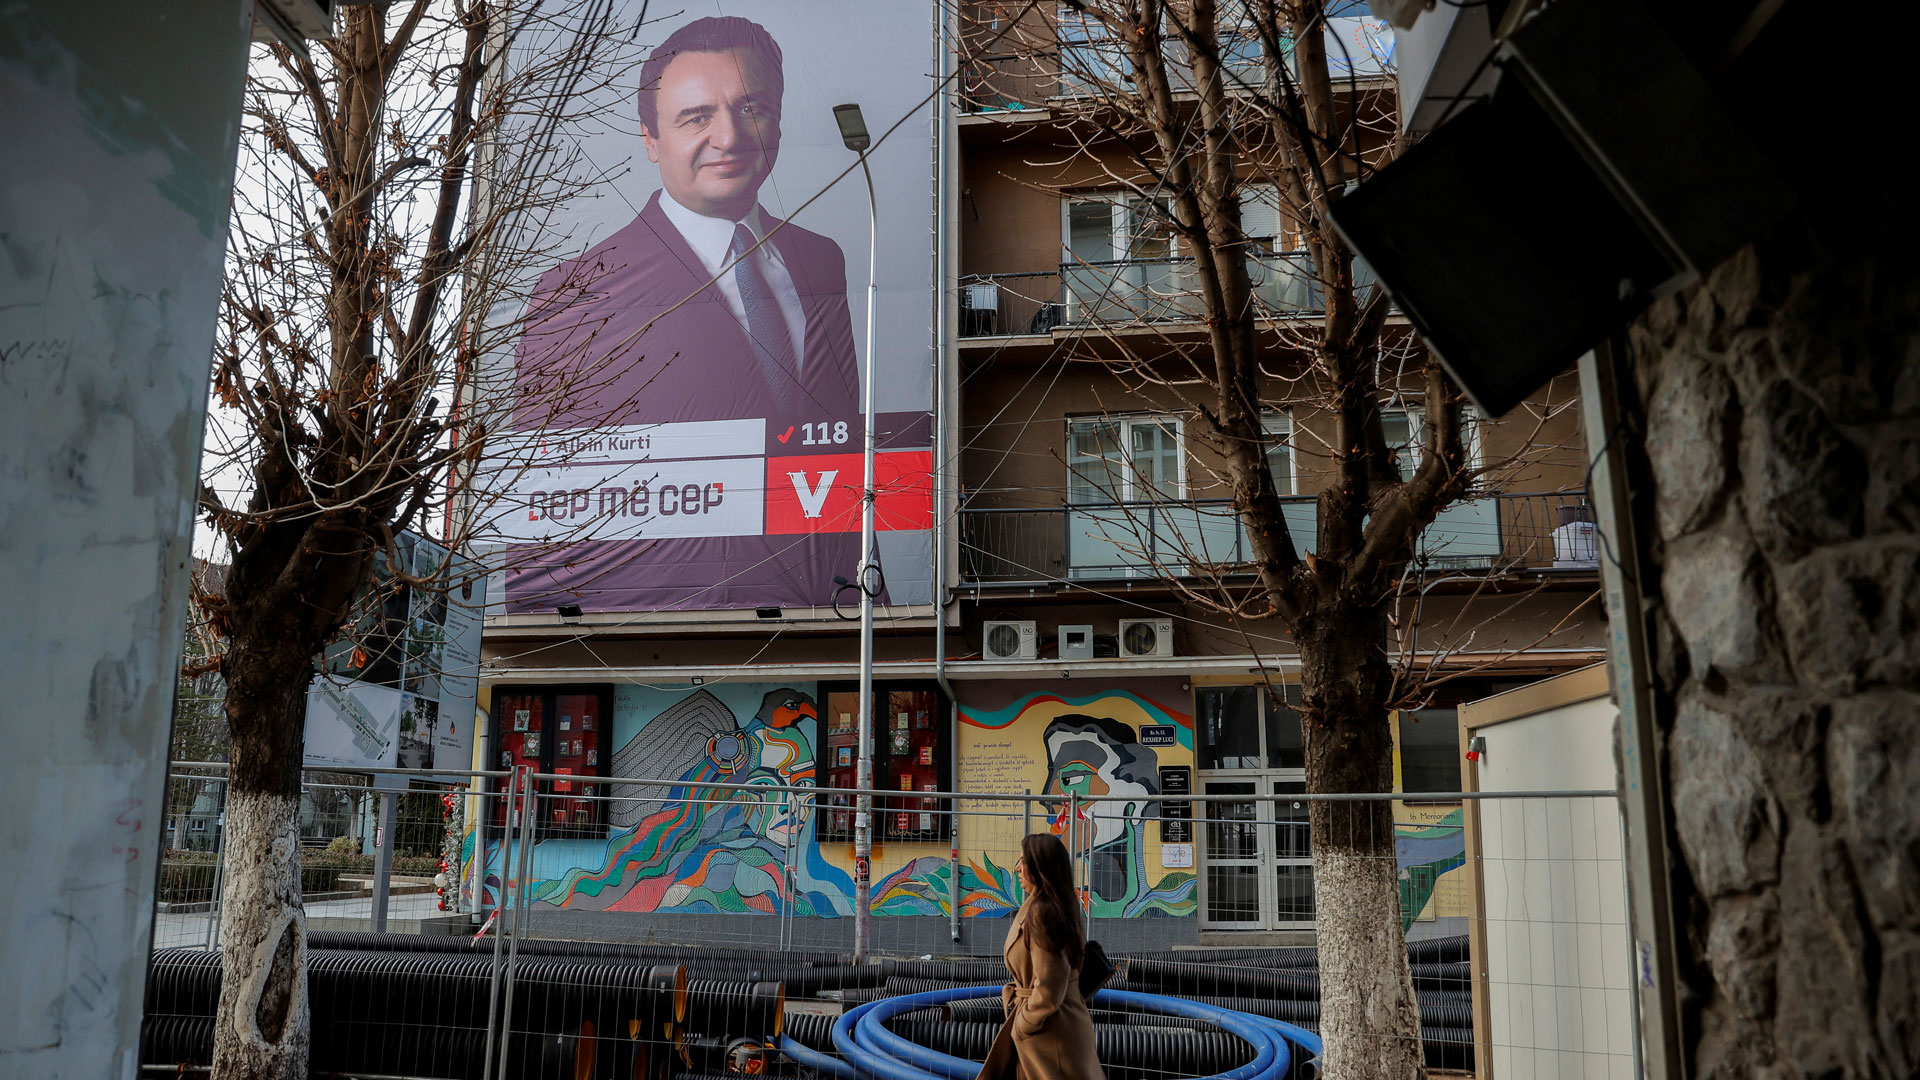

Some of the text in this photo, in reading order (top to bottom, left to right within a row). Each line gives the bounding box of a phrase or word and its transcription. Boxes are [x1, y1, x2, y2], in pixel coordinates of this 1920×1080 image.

[556, 437, 603, 454] Albin
[608, 434, 651, 451] Kurti
[801, 421, 849, 445] 118
[598, 479, 650, 518] më
[785, 469, 840, 520] V
[1420, 812, 1456, 820] Memoriam
